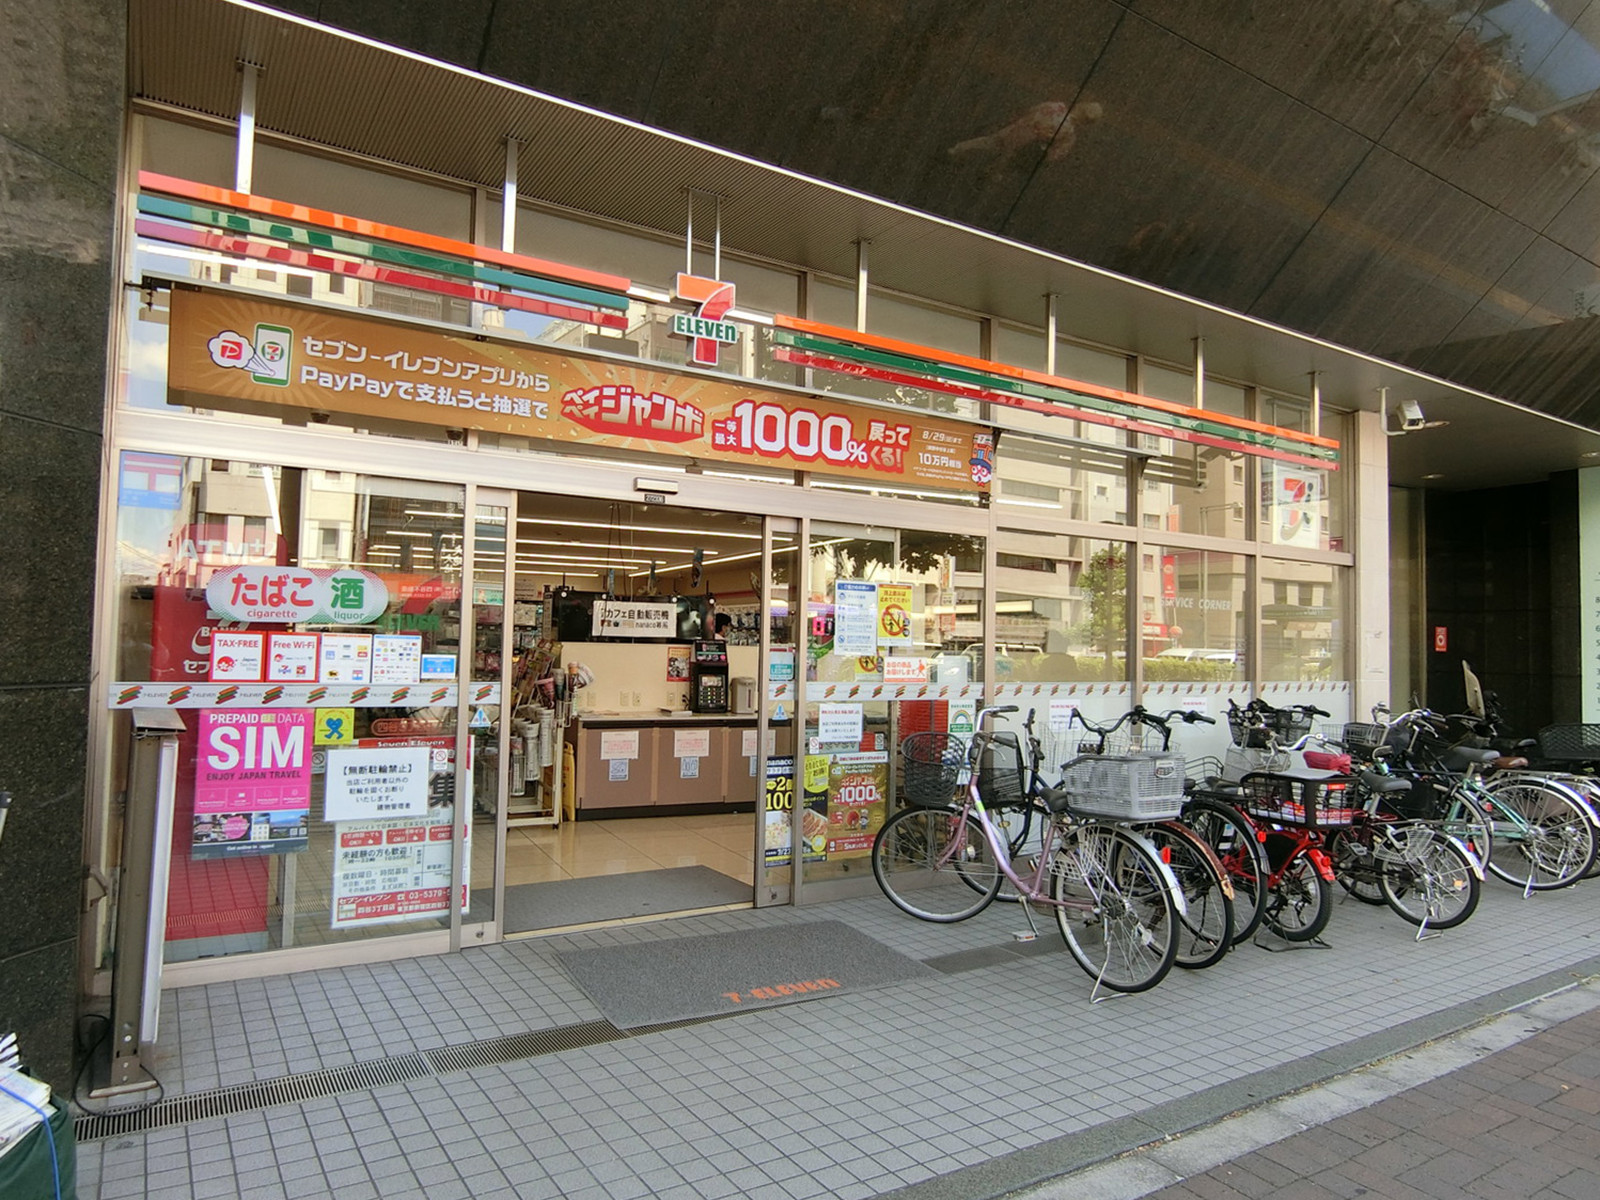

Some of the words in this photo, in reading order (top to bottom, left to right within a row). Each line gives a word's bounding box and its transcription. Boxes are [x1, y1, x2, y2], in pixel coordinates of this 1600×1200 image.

[300, 364, 549, 419] PayPayで支払うと抽選で
[869, 421, 911, 447] 戻って
[231, 572, 314, 608] たばこ
[330, 576, 365, 609] 酒
[1160, 597, 1194, 608] SERVICE
[1198, 599, 1233, 611] CORNER
[246, 608, 298, 620] cigarette
[334, 611, 365, 622] liquor
[217, 639, 259, 648] TAX-FREE
[273, 641, 292, 649] Free
[293, 641, 315, 649] Wi-Fi
[209, 713, 258, 724] PREPAID
[276, 713, 305, 723] DATA
[207, 725, 305, 771] SIM
[206, 773, 235, 781] ENJOY
[238, 772, 266, 780] JAPAN
[270, 771, 301, 779] TRAVEL
[776, 776, 786, 791] 2
